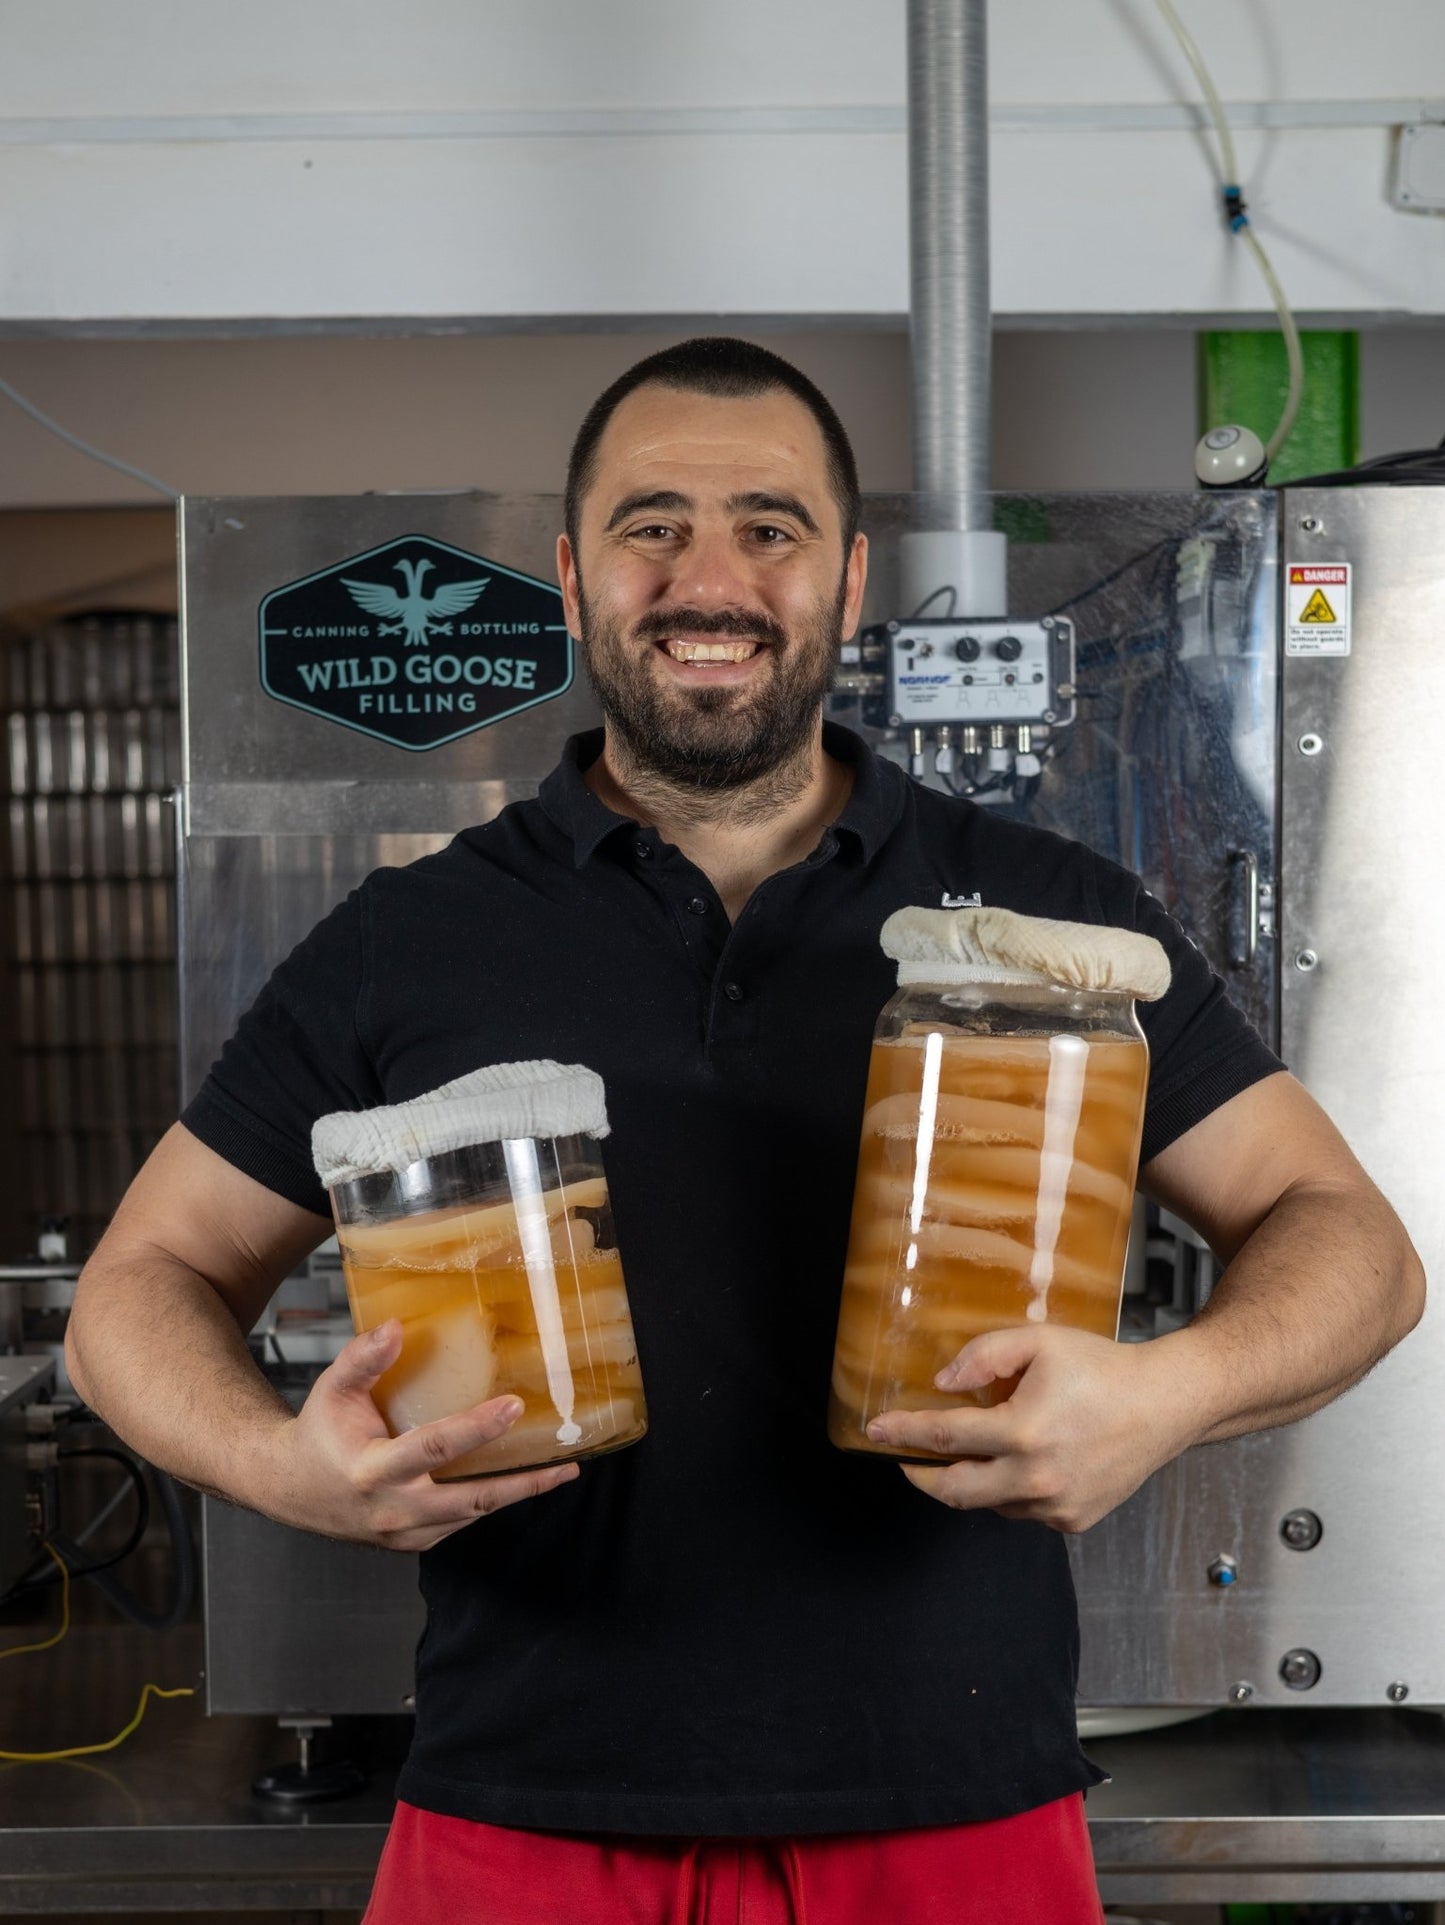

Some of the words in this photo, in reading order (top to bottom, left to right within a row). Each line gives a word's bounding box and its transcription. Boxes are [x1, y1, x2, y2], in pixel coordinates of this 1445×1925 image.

[1303, 570, 1345, 582] DANGER
[292, 625, 370, 638] CANNING
[460, 622, 540, 636] BOTTLING
[297, 655, 397, 692] WILD
[405, 654, 538, 691] GOOSE
[359, 693, 476, 714] FILLING
